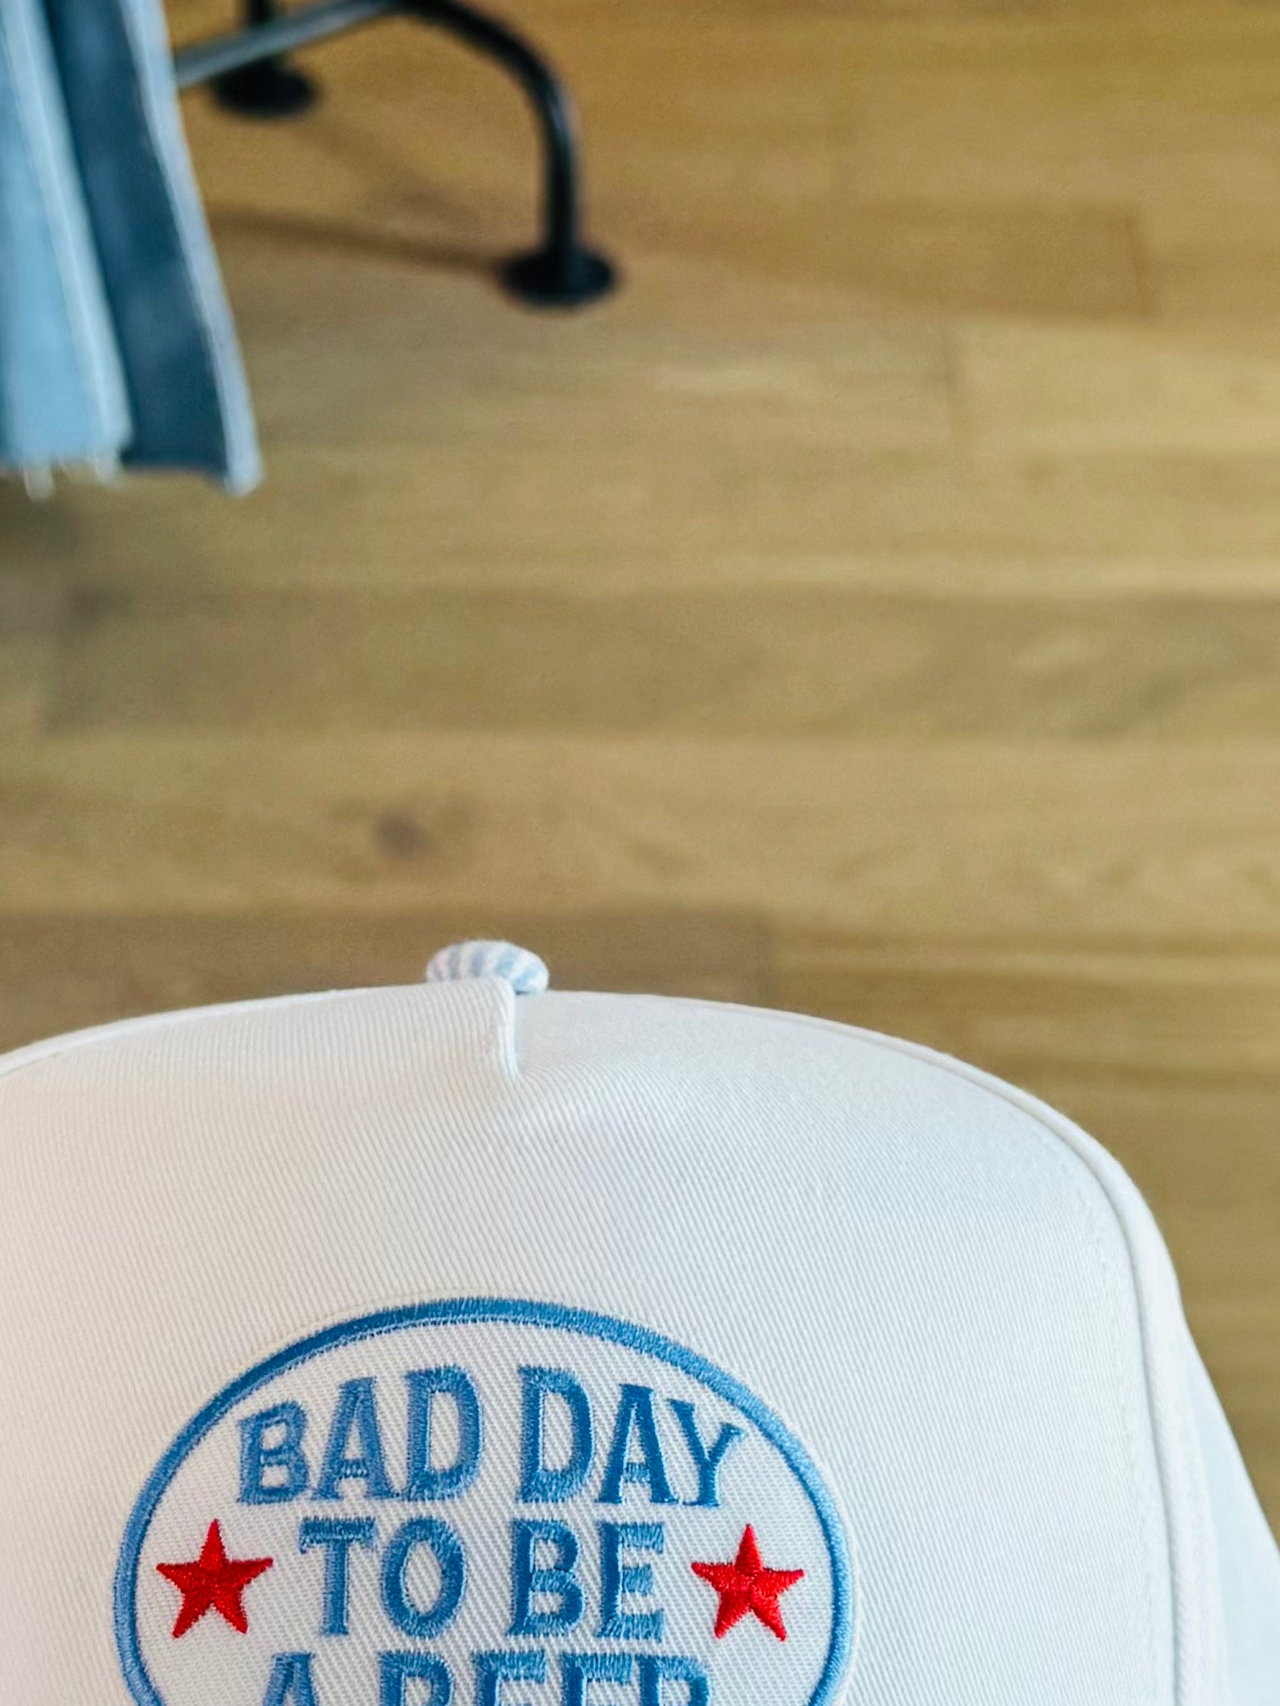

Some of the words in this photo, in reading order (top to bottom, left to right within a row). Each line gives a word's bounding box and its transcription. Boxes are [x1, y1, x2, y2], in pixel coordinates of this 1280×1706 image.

[239, 1364, 481, 1506] BAD
[516, 1366, 747, 1507] DAY
[299, 1517, 464, 1638] TO
[508, 1518, 664, 1642] BE
